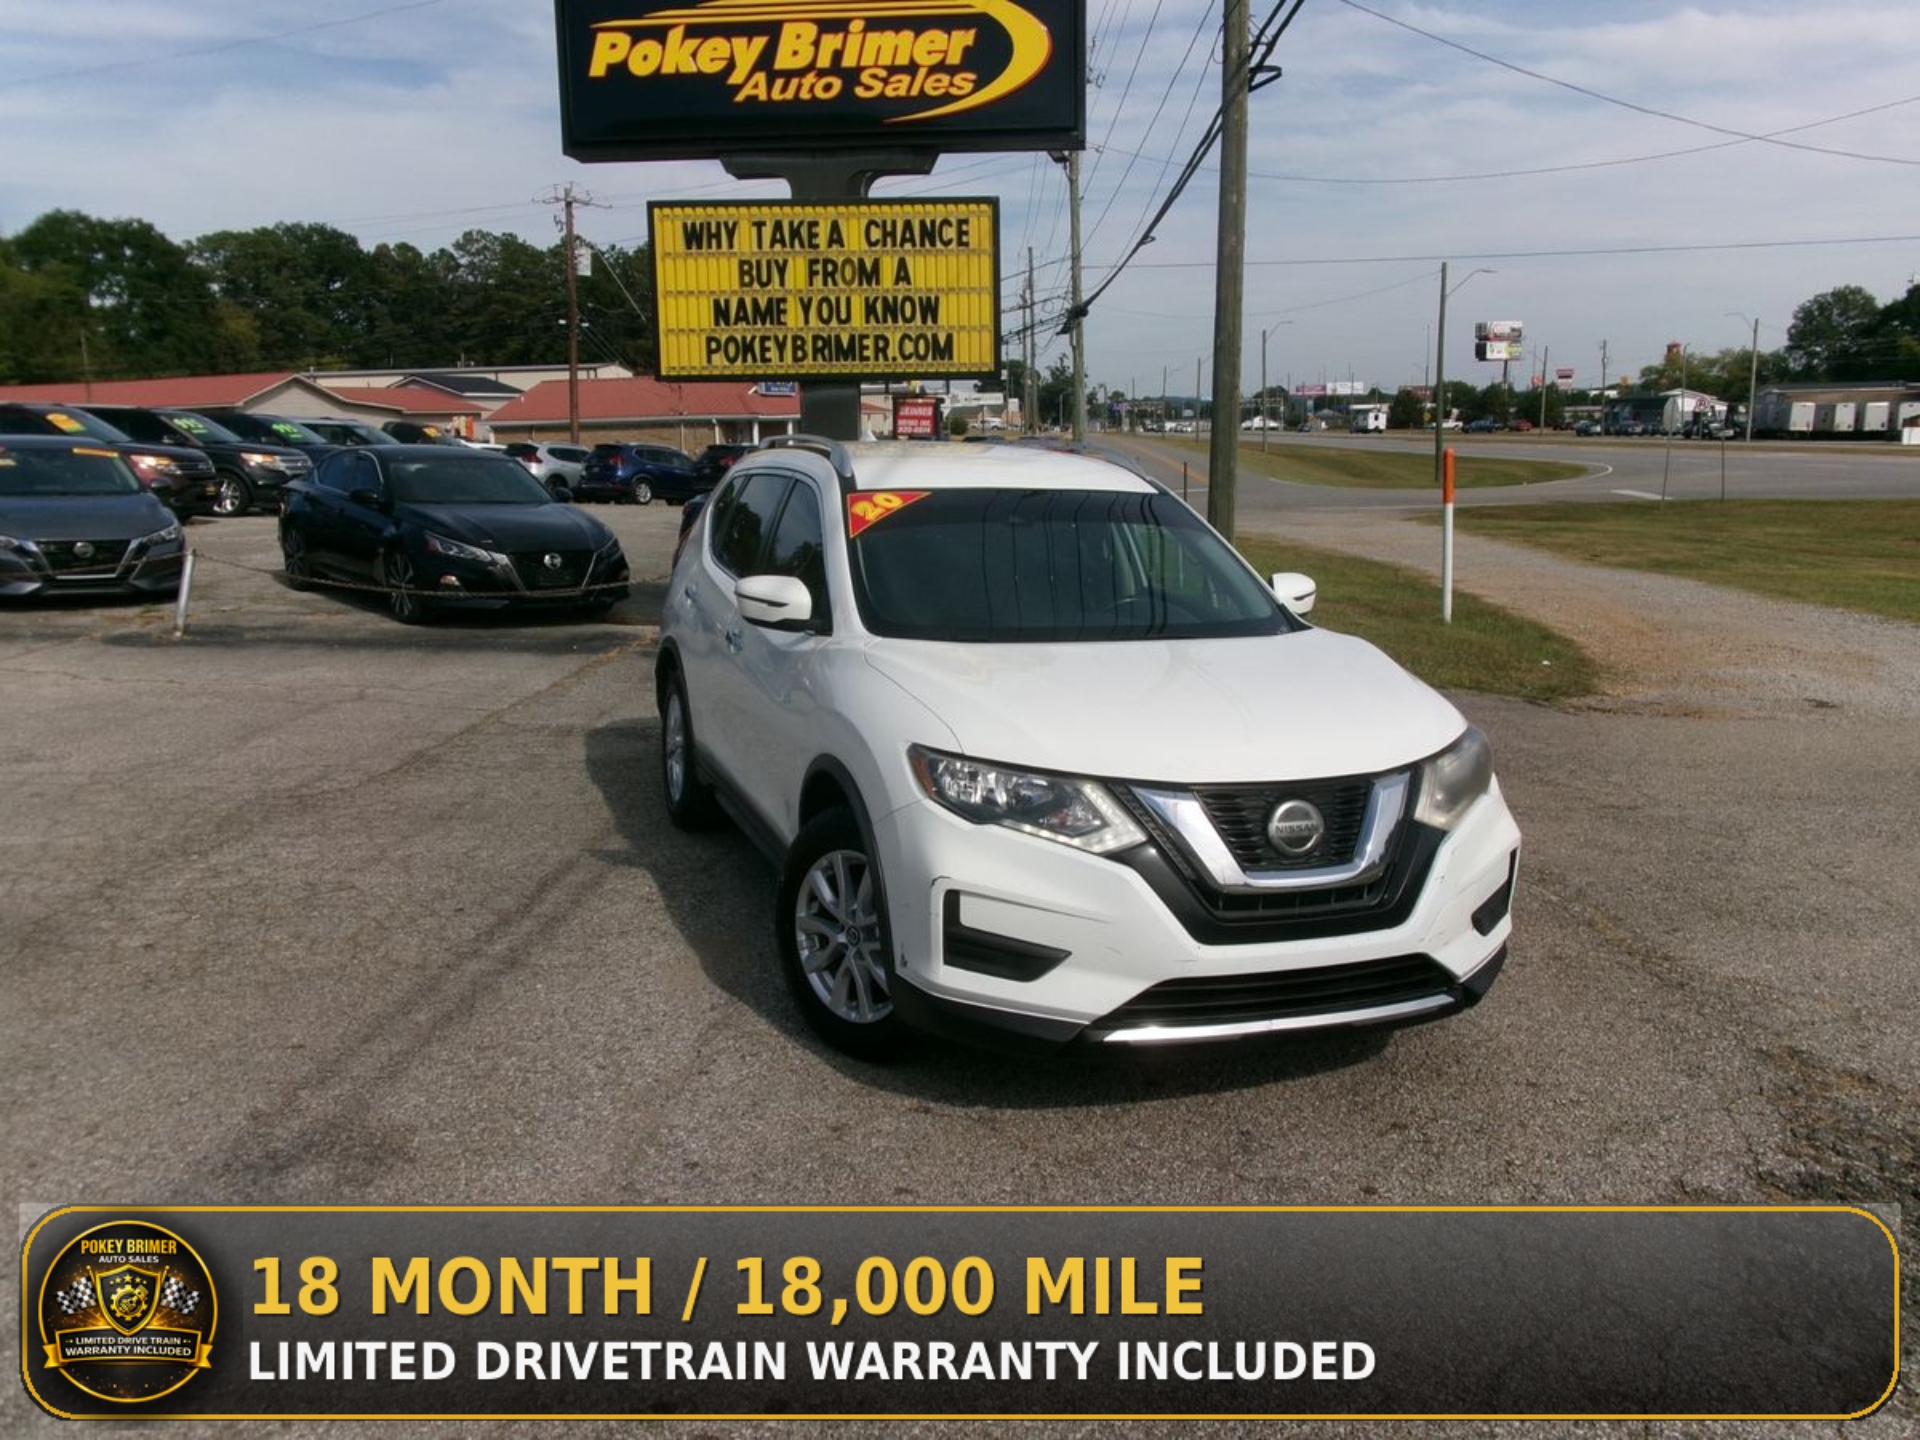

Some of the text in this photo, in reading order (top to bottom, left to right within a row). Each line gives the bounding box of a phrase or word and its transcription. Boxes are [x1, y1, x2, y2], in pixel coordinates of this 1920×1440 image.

[588, 19, 978, 85] Pokey Brimer
[733, 66, 977, 101] Auto Sales
[682, 218, 970, 250] WHY TAKE A CHANCE
[738, 257, 912, 288] BUY FROM A
[713, 296, 940, 326] NAME YOU KNOW
[706, 333, 954, 364] POKEYBRIMER.COM
[851, 492, 903, 520] 20
